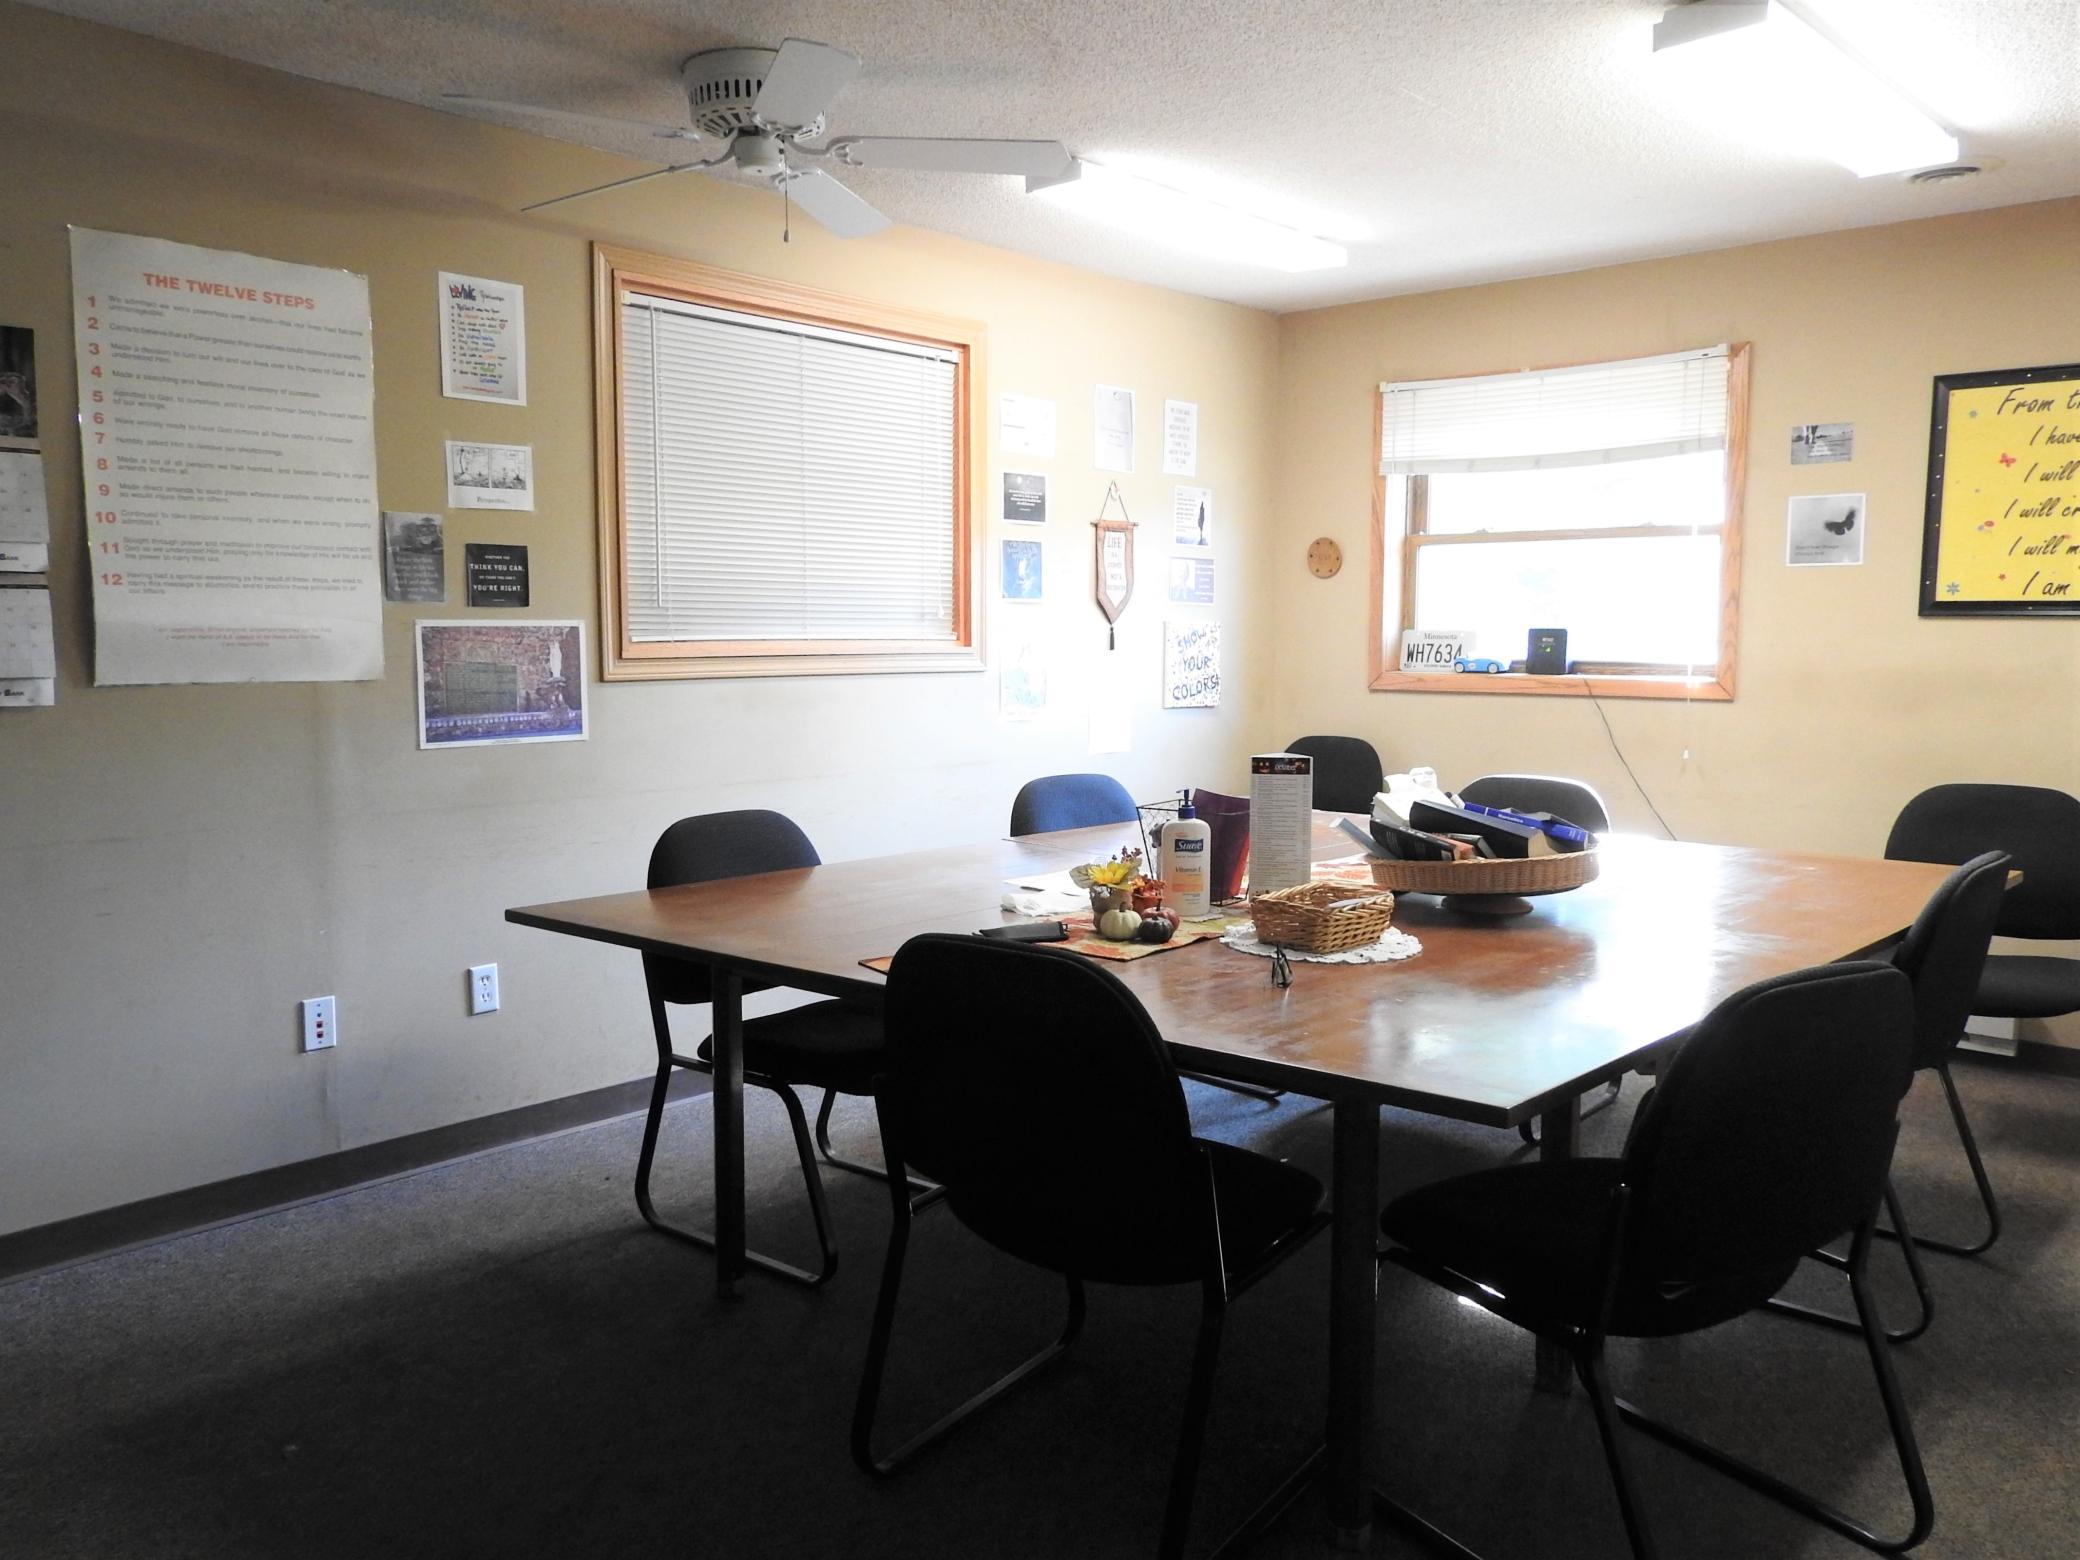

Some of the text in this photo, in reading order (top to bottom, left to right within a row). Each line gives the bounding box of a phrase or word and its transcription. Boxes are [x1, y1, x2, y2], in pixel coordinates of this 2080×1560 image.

[143, 273, 315, 311] THE TWELVE STEPS
[88, 295, 96, 308] 1
[88, 316, 99, 330] 2
[88, 342, 100, 355] 3
[91, 365, 103, 379] 4
[93, 390, 103, 403] 5
[1997, 387, 2055, 415] From
[93, 411, 105, 425] 6
[94, 431, 106, 445] 7
[2029, 425, 2044, 446] I
[97, 457, 109, 471] 8
[2024, 460, 2080, 483] I will
[98, 484, 110, 497] 9
[2003, 498, 2019, 519] I
[2020, 497, 2061, 518] will
[95, 511, 117, 524] 10
[101, 541, 120, 554] 11
[1107, 535, 1123, 549] LIFE
[2008, 535, 2023, 556] I
[2024, 535, 2065, 555] will
[102, 573, 123, 586] 12
[2022, 570, 2071, 596] I am
[473, 584, 498, 592] YOU'RE
[1178, 628, 1207, 654] SHOW
[1424, 632, 1458, 641] Minnesota
[1406, 643, 1463, 663] WH7634
[1183, 655, 1212, 672] YOUR
[1178, 841, 1203, 850] Suave
